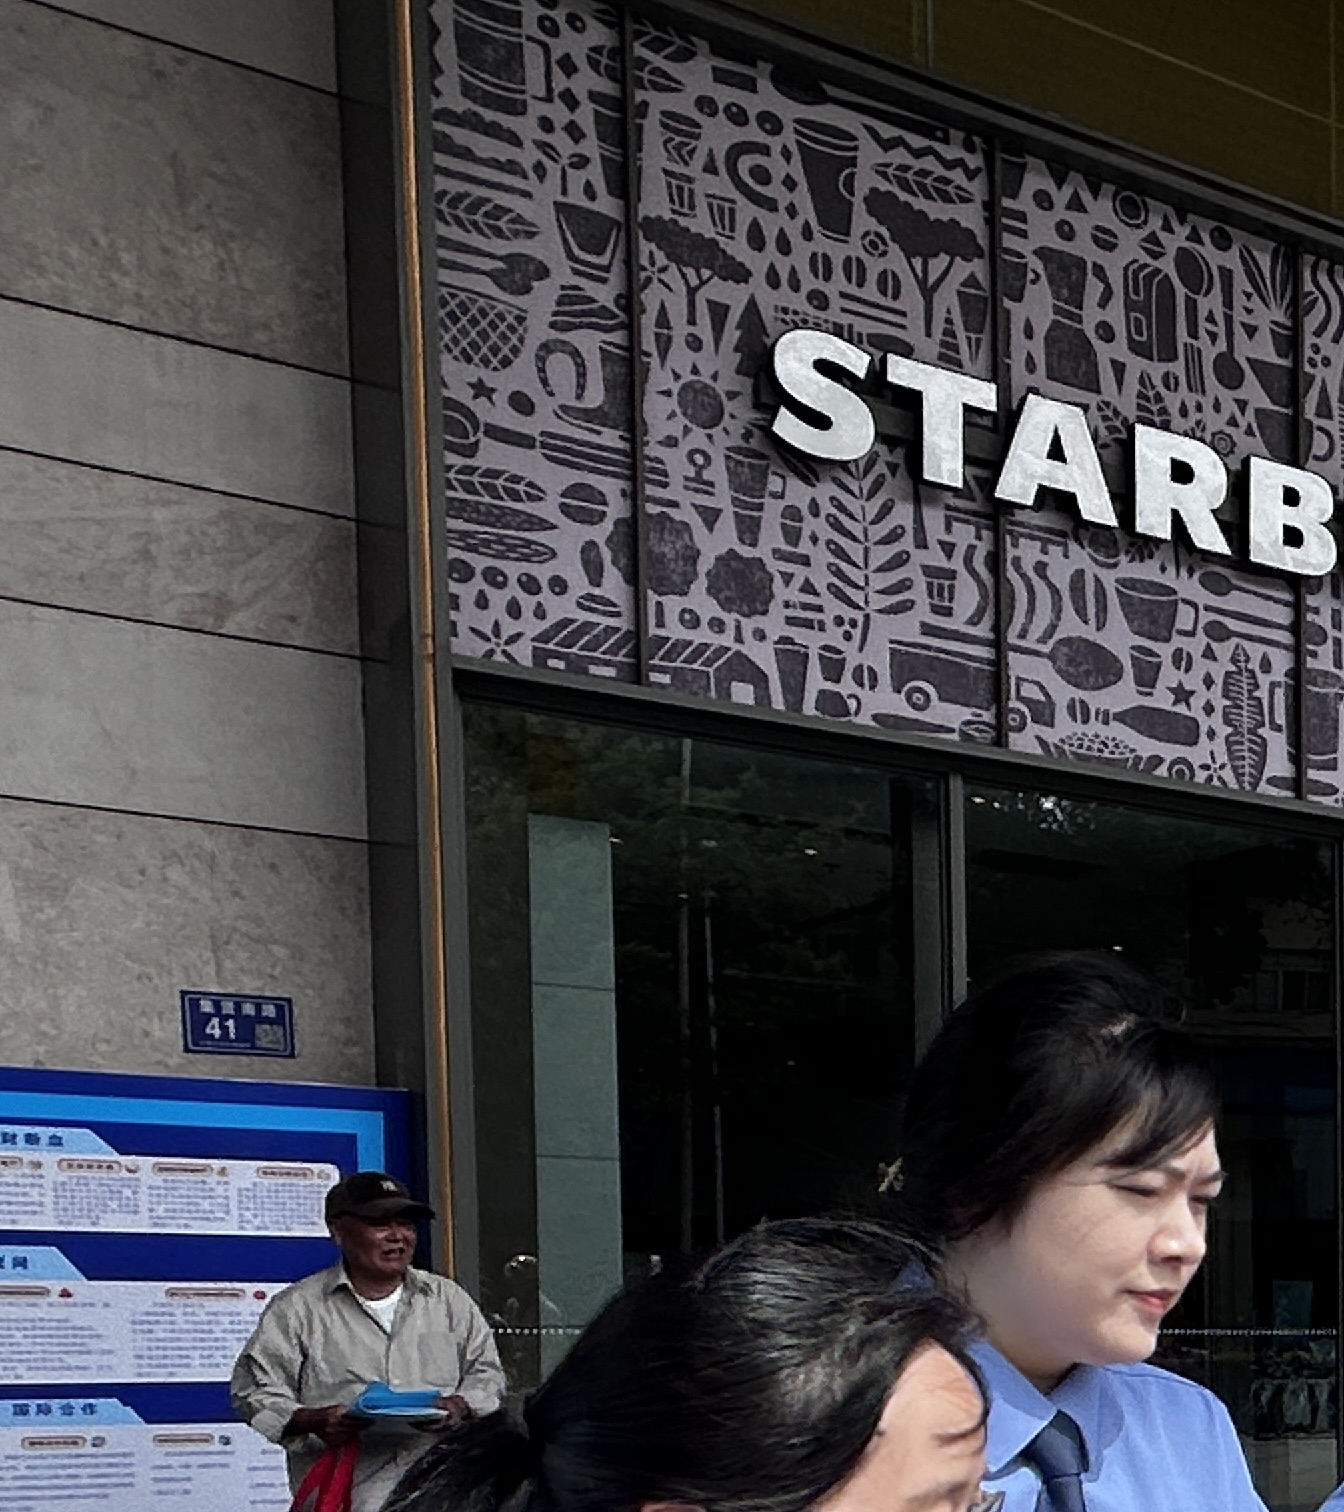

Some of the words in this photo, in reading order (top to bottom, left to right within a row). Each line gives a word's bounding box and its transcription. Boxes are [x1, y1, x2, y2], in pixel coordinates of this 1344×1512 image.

[205, 1016, 236, 1040] 41
[12, 1402, 98, 1417] 国际合作
